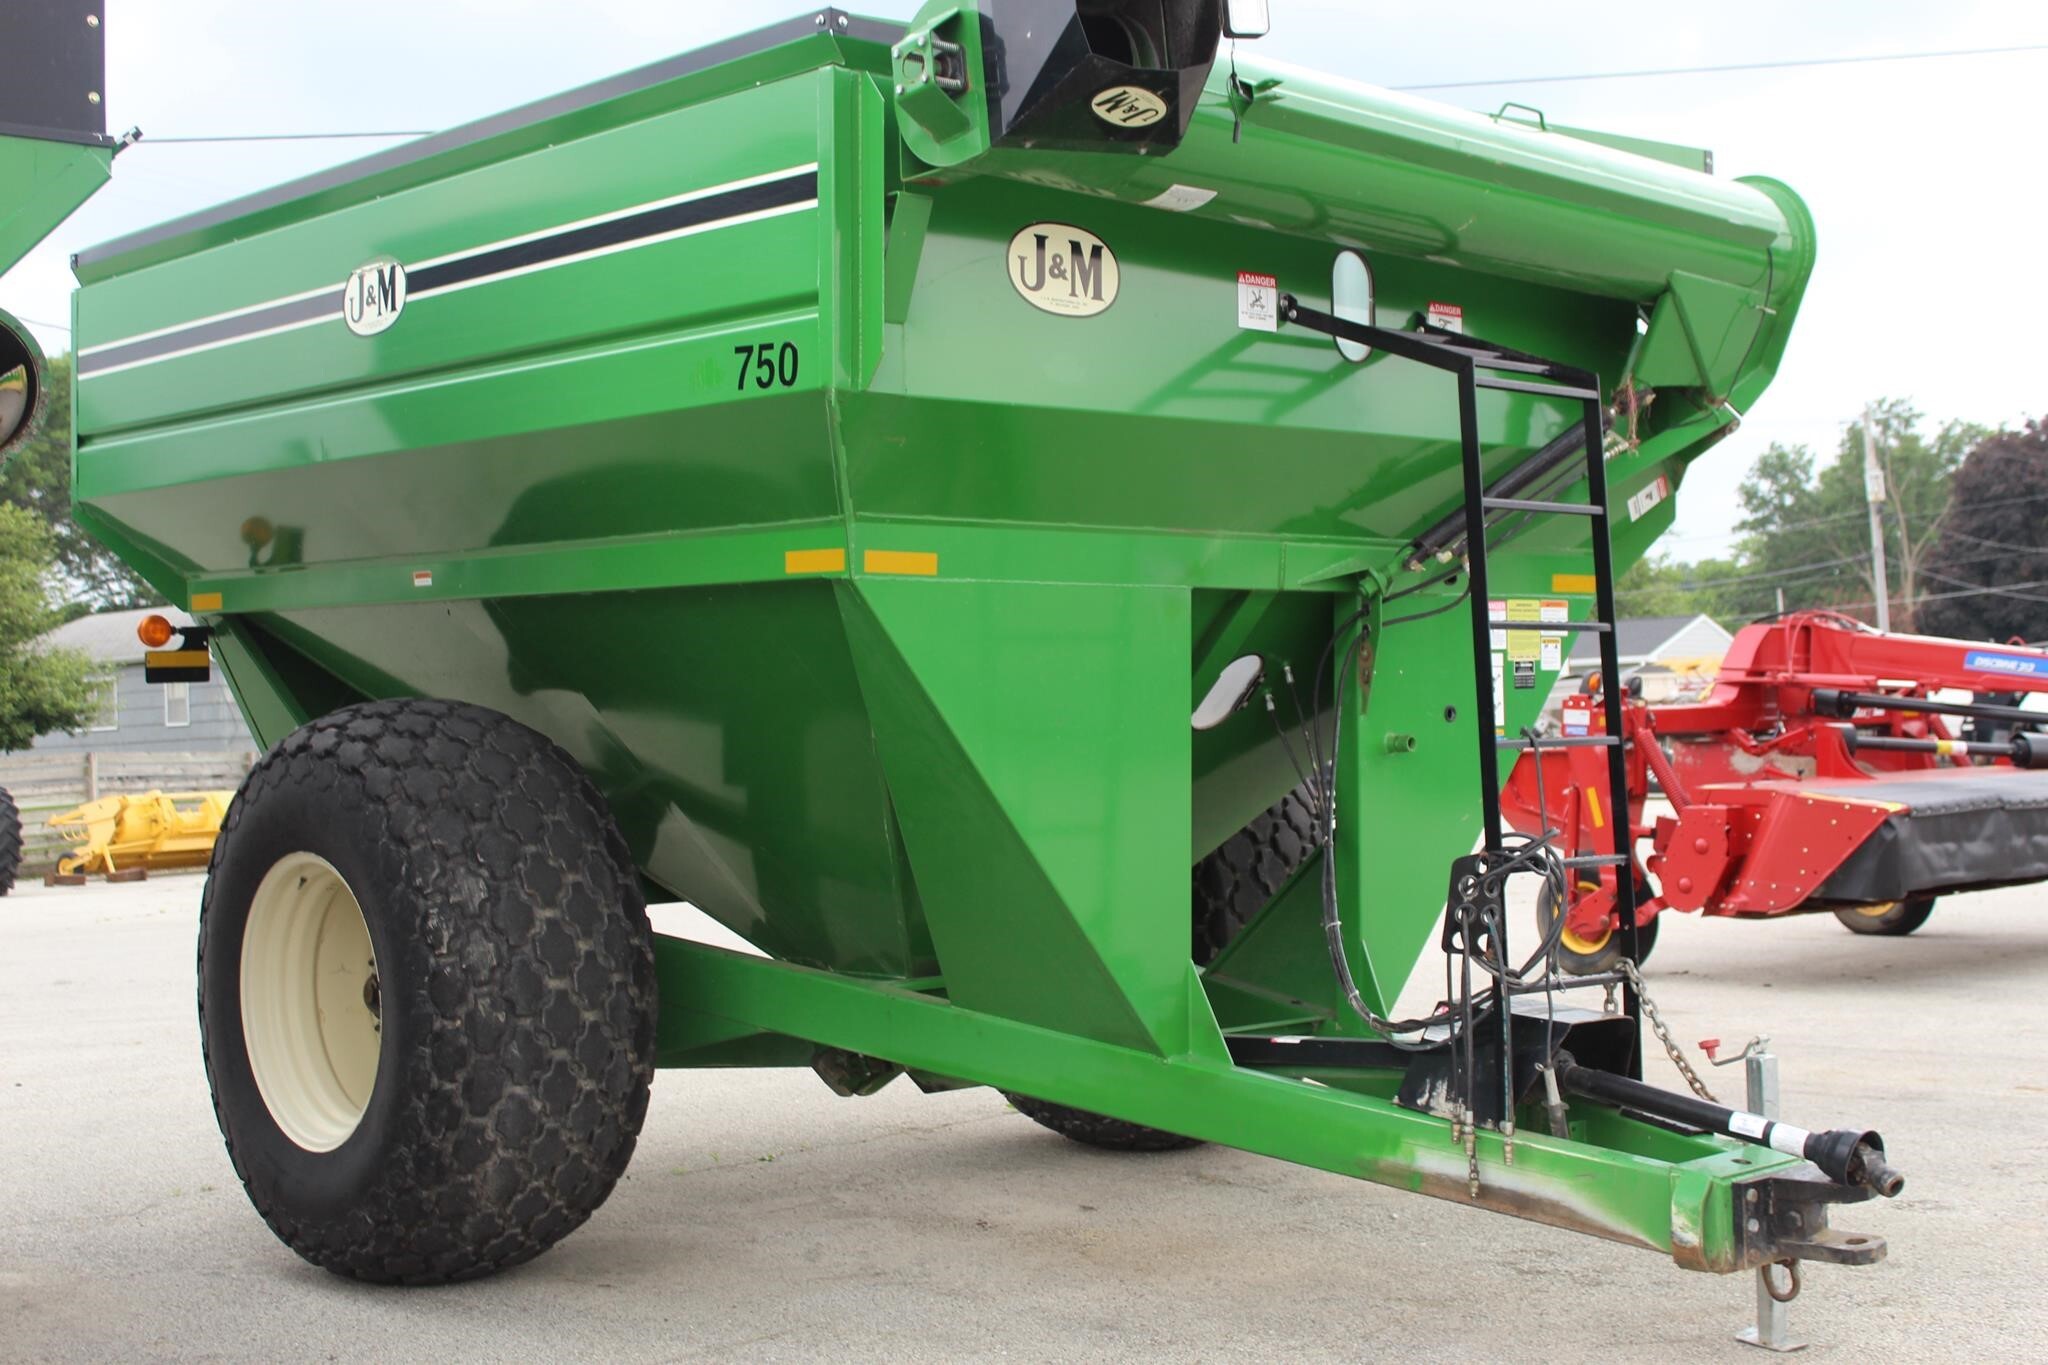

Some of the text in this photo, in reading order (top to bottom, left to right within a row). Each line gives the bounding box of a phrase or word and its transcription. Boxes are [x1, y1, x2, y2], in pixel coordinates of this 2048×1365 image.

[1094, 89, 1159, 123] J&M
[1018, 233, 1106, 303] J&M
[1245, 274, 1276, 287] DANGER
[349, 263, 398, 323] J&M
[1436, 303, 1462, 316] DANGER
[734, 341, 799, 391] 750
